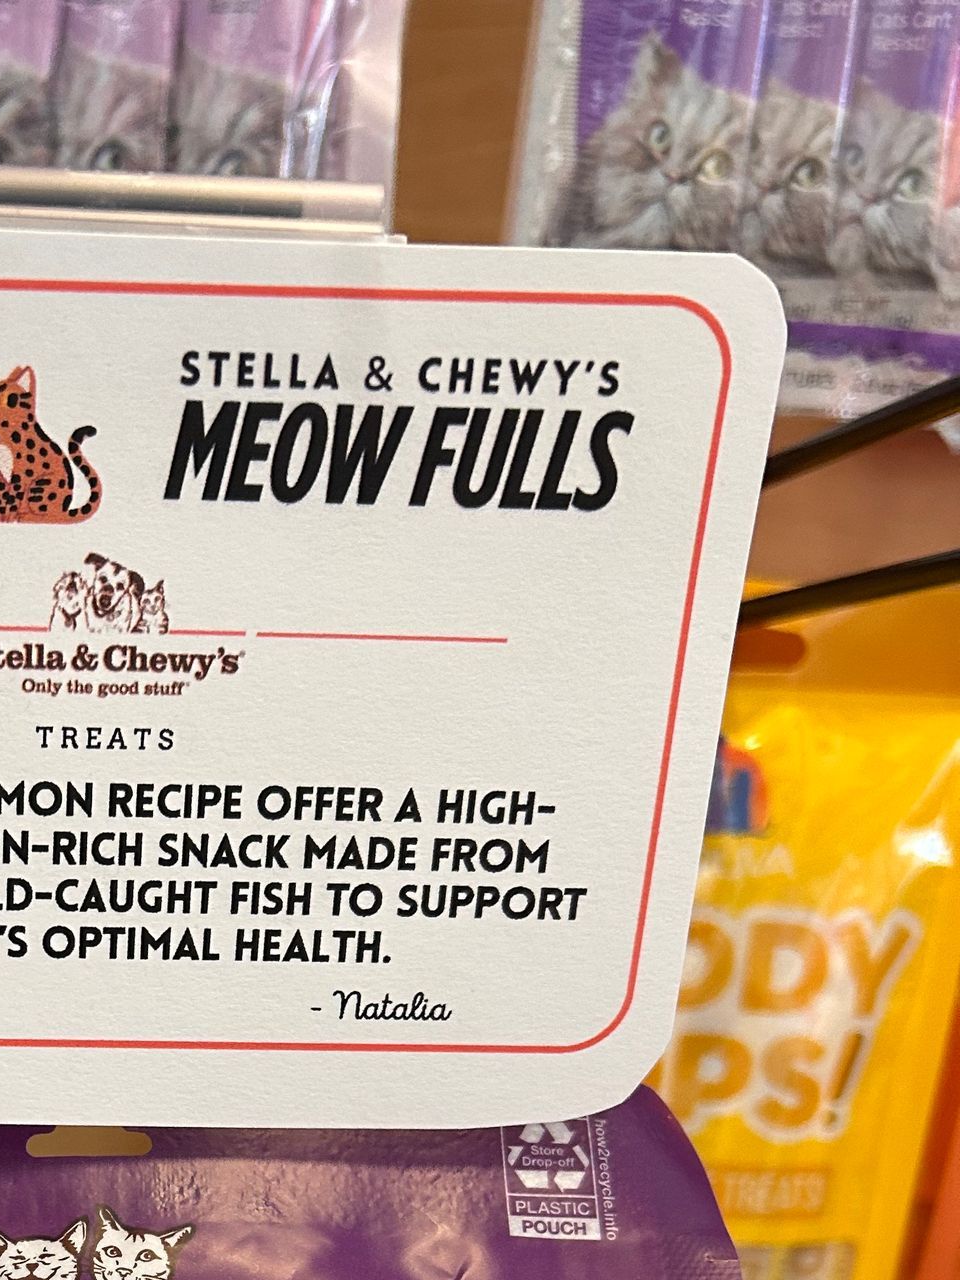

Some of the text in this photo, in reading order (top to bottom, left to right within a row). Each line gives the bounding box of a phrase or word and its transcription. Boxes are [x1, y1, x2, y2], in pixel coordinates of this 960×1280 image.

[180, 350, 620, 397] STELLA & CHEWY'S
[163, 400, 635, 511] MEOW FULLS
[71, 644, 99, 672] &
[22, 678, 62, 696] Only
[67, 679, 93, 694] the
[98, 681, 139, 698] good
[36, 726, 175, 751] TREATS
[108, 783, 242, 820] RECIPE
[256, 785, 382, 824] OFFER
[393, 788, 422, 824] A
[437, 789, 556, 826] HIGH-
[157, 832, 290, 870] SNACK
[303, 836, 417, 873] MADE
[431, 838, 551, 874] FROM
[230, 881, 312, 917] FISH
[326, 883, 385, 918] TO
[396, 884, 589, 921] SUPPORT
[41, 926, 220, 961] OPTIMAL
[234, 928, 393, 965] HEALTH.
[333, 990, 453, 1023] Natalia
[522, 1157, 575, 1168] Drop-off
[530, 1144, 564, 1156] Store
[594, 1118, 619, 1241] how2recycle.info
[515, 1200, 590, 1216] PLASTIC
[521, 1220, 587, 1236] POUCH
